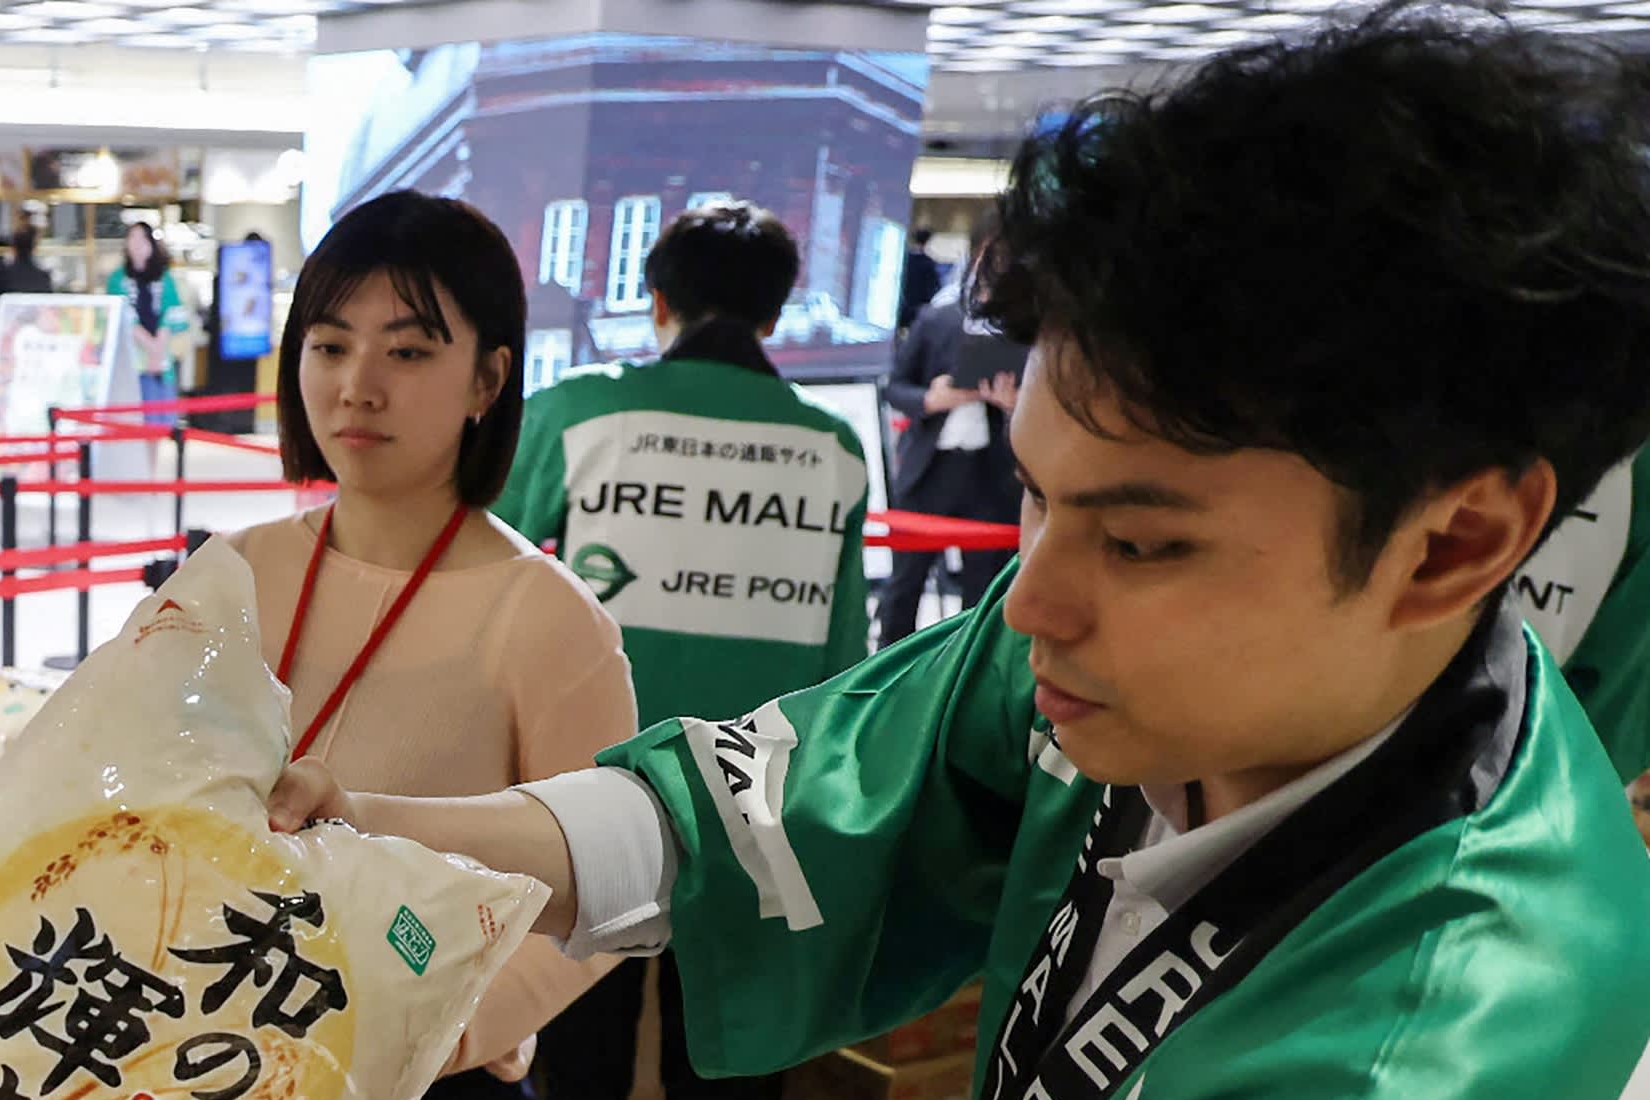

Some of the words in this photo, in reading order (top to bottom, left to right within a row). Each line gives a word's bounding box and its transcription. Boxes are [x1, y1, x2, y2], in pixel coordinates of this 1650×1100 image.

[579, 481, 687, 520] JRE
[703, 489, 847, 536] MALL
[660, 570, 736, 599] JRE
[747, 575, 834, 607] POIN
[1063, 919, 1246, 1093] JRE
